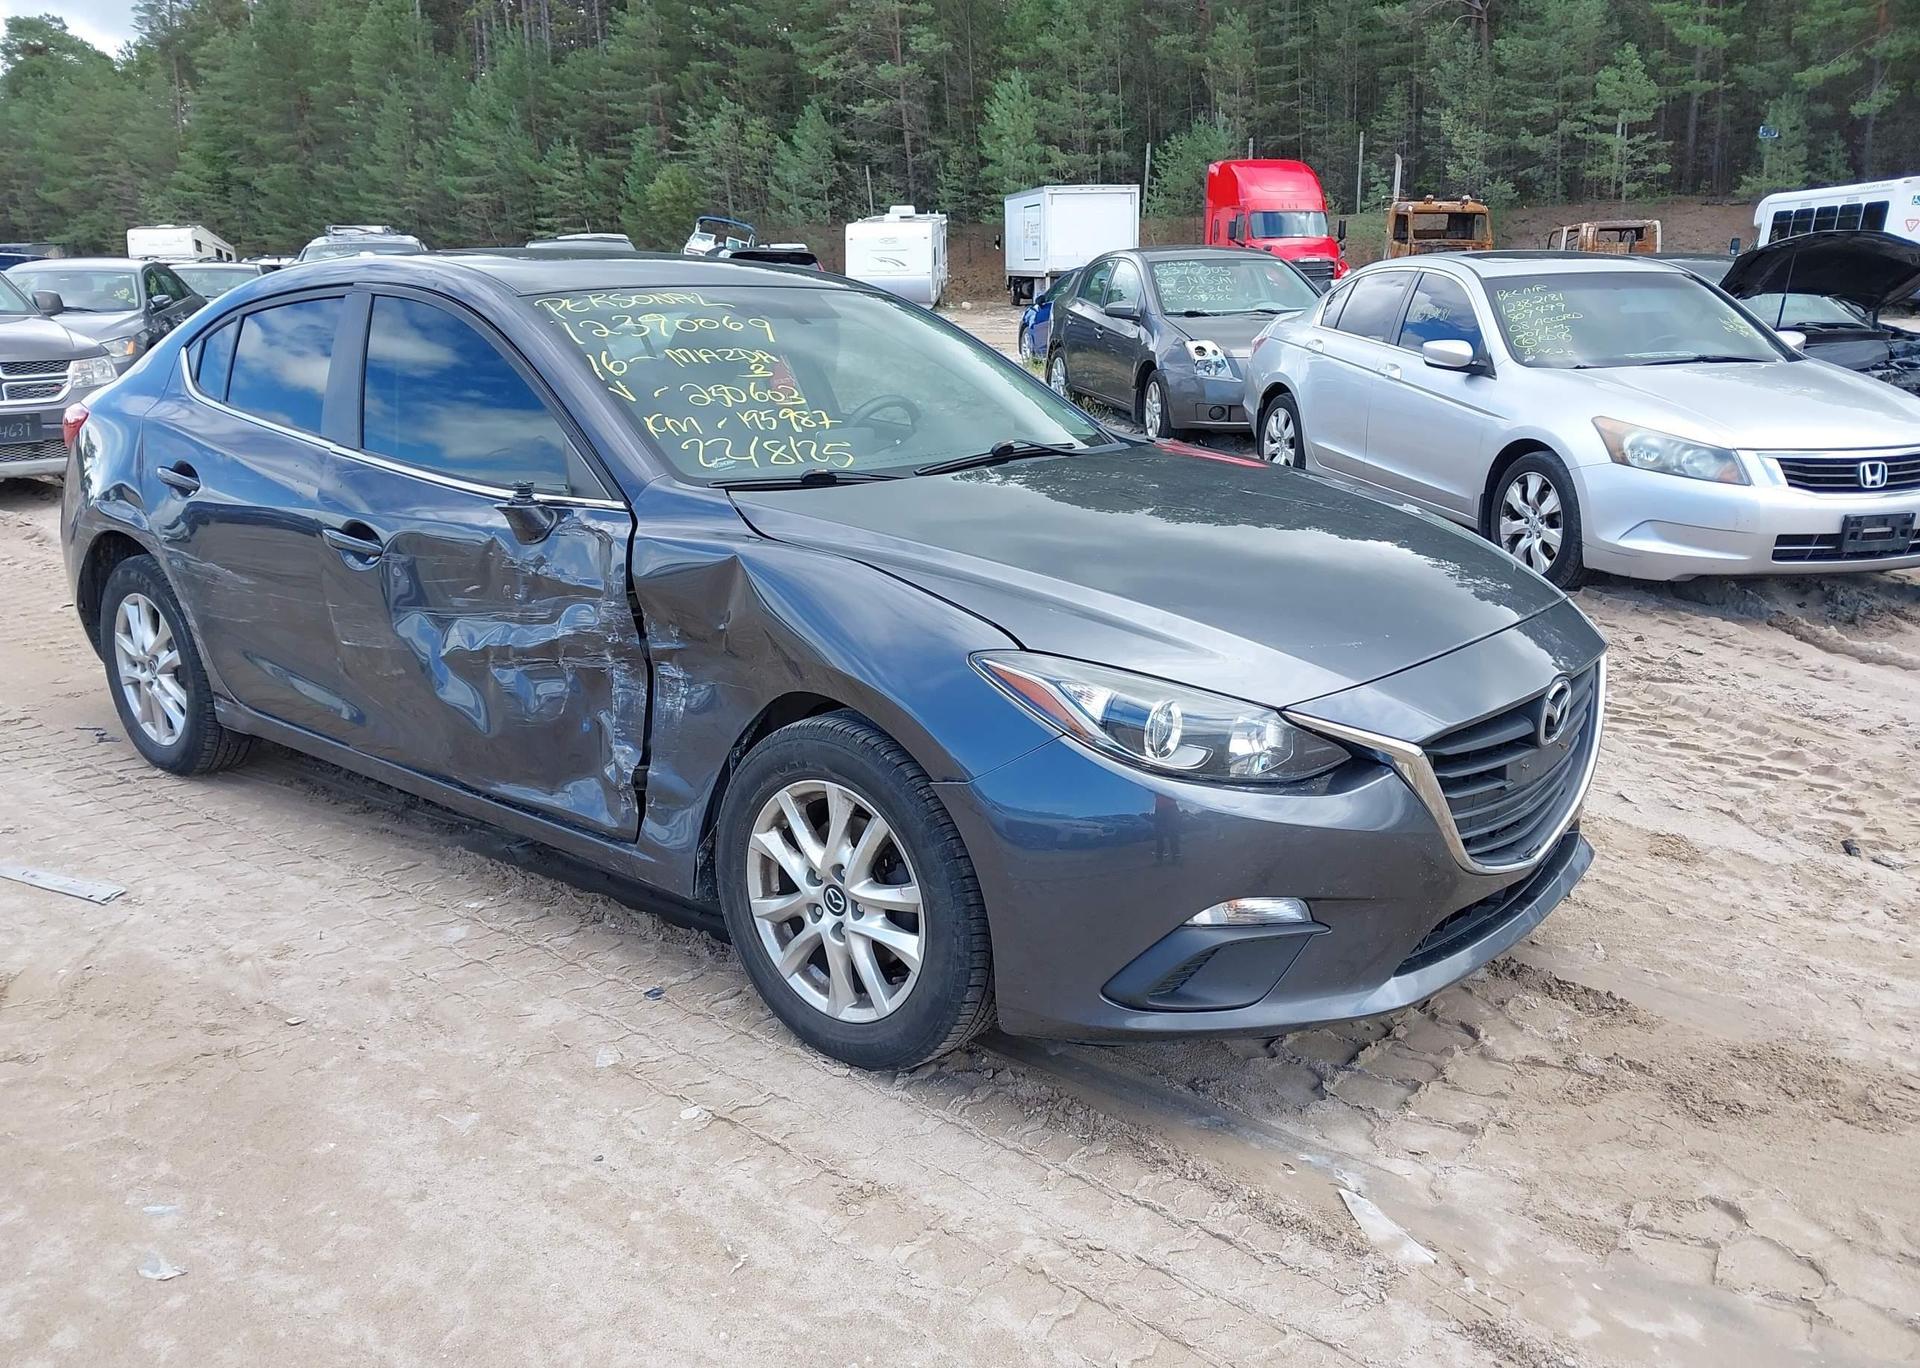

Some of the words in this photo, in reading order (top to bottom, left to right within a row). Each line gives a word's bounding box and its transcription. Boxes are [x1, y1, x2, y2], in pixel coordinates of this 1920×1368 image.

[534, 292, 736, 320] PERSONAL
[1534, 312, 1583, 327] ACCORD
[562, 313, 776, 345] 12390069
